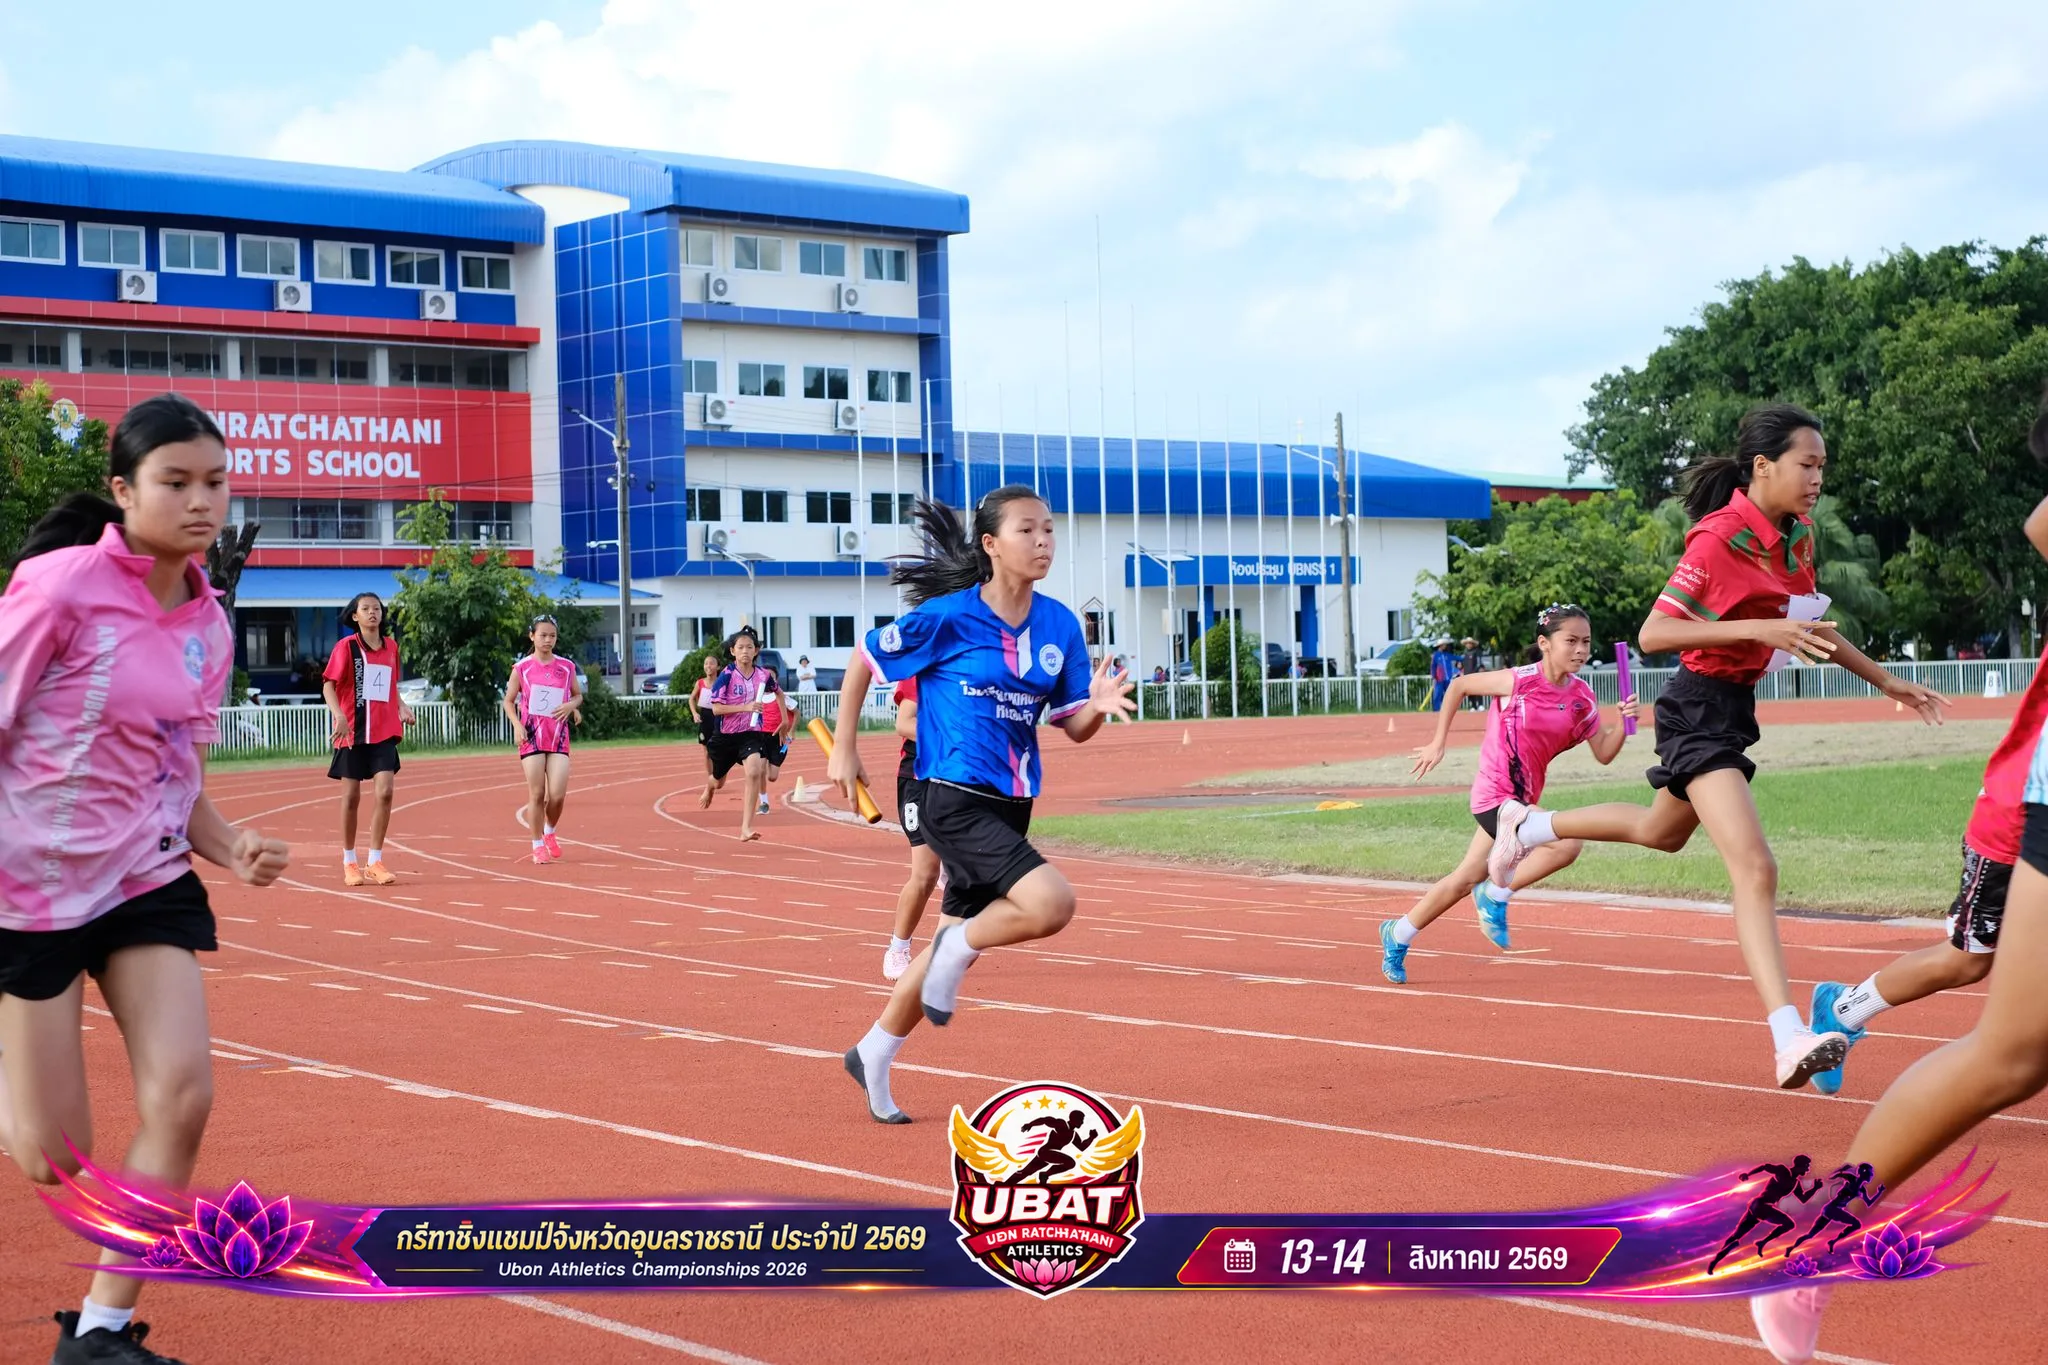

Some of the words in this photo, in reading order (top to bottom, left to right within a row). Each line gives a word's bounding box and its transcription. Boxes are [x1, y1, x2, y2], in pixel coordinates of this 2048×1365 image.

[307, 449, 421, 478] SCHOOL
[1329, 562, 1336, 576] 1
[373, 671, 385, 693] 4
[537, 690, 550, 712] 3
[904, 802, 919, 832] 8
